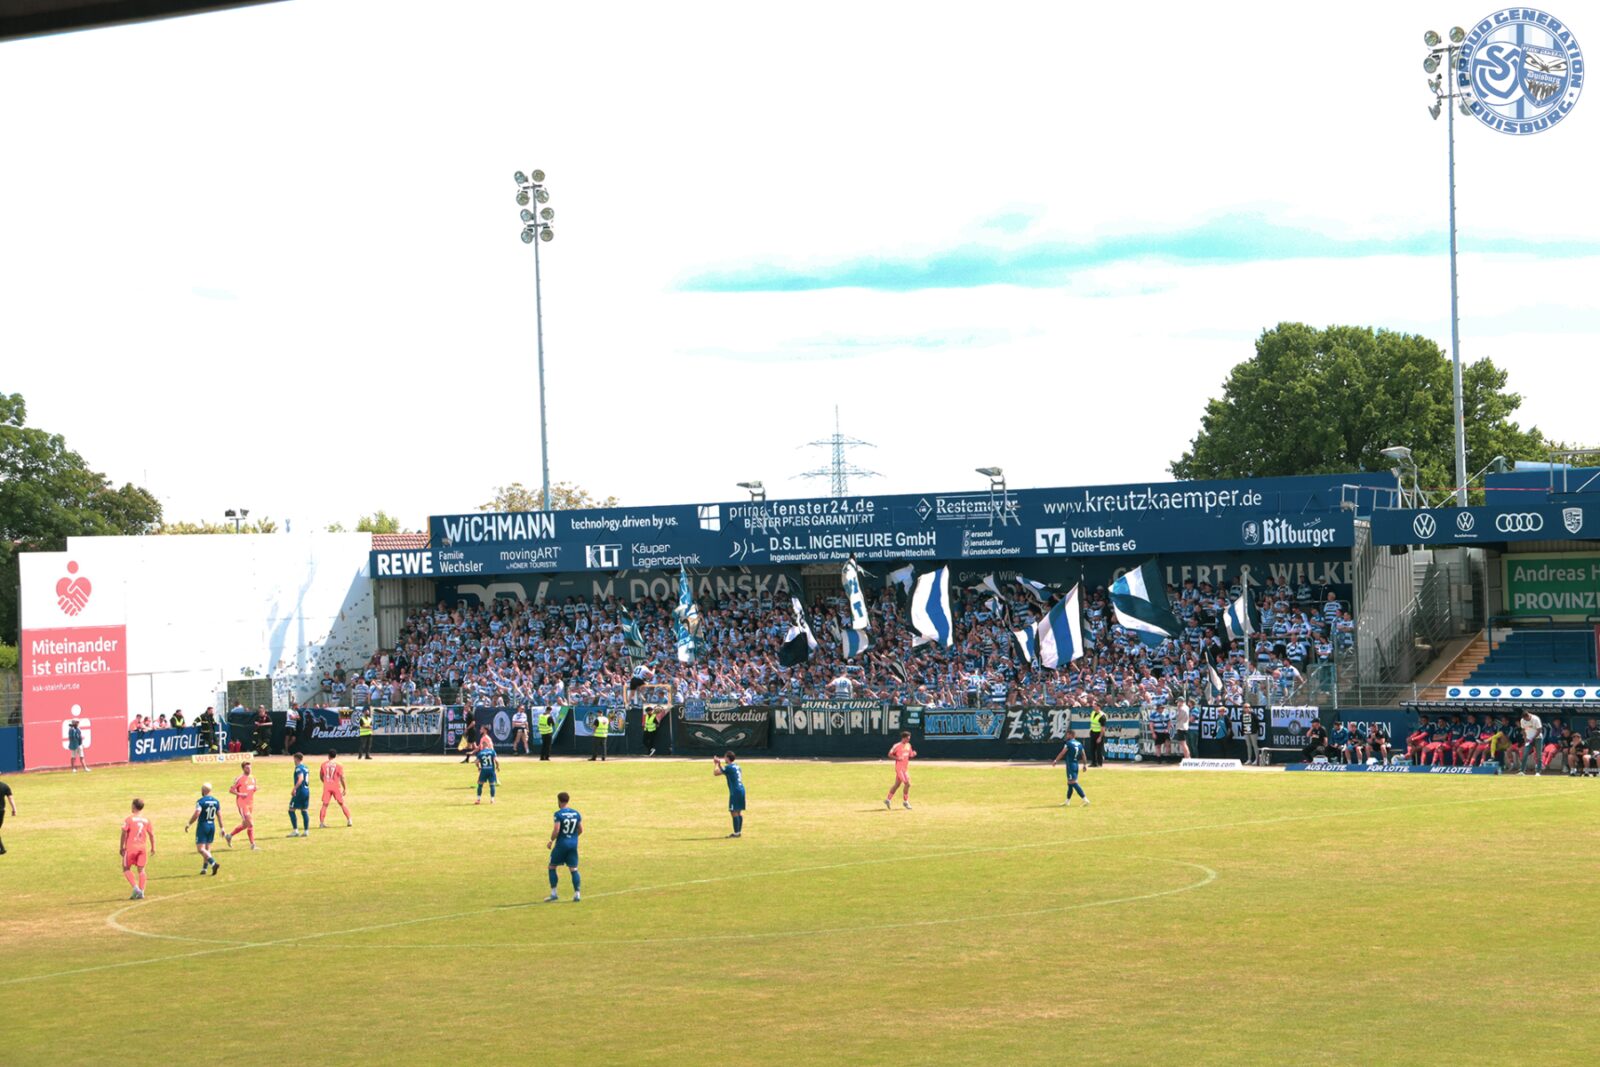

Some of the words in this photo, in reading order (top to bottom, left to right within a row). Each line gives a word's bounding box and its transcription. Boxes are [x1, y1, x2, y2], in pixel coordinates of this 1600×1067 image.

[1044, 487, 1262, 514] www.kreutzkaemper.de
[652, 514, 663, 530] by
[664, 516, 679, 526] us.
[1071, 526, 1124, 538] Volksbank
[1262, 518, 1336, 547] Bitburger
[769, 536, 806, 551] D.S.L.
[809, 533, 893, 549] INGENIEURE
[895, 531, 936, 547] GmbH
[1071, 541, 1120, 553] Düte-Ems
[1121, 540, 1137, 551] eG
[439, 551, 464, 560] Familie
[585, 543, 622, 568] KLT
[631, 543, 671, 555] Käuper
[1001, 547, 1021, 555] GmbH
[632, 553, 701, 568] Lagertechnik
[769, 553, 818, 564] Ingenieurbüro
[819, 552, 829, 560] für
[830, 551, 868, 560] Abwaser-
[869, 551, 883, 559] und
[884, 549, 936, 558] Umwelttechnik
[377, 552, 433, 576] REWE
[440, 561, 483, 573] Wechsler
[1514, 564, 1585, 582] Andreas
[32, 636, 118, 656] Miteinander
[32, 659, 51, 675] ist
[55, 657, 111, 673] einfach.
[32, 682, 80, 692] ksk-steinfurt.de
[711, 709, 768, 723] Generation
[774, 710, 900, 730] KOHORTE
[1273, 709, 1316, 718] MSV-FANS
[135, 737, 157, 755] SFL
[159, 731, 228, 752] MITGLIER
[1273, 735, 1312, 745] HOCHFE
[195, 755, 219, 763] WEST
[225, 753, 252, 762] LOTTO
[482, 755, 493, 766] 31
[325, 767, 336, 780] 17
[205, 805, 217, 819] 10
[563, 818, 578, 834] 37
